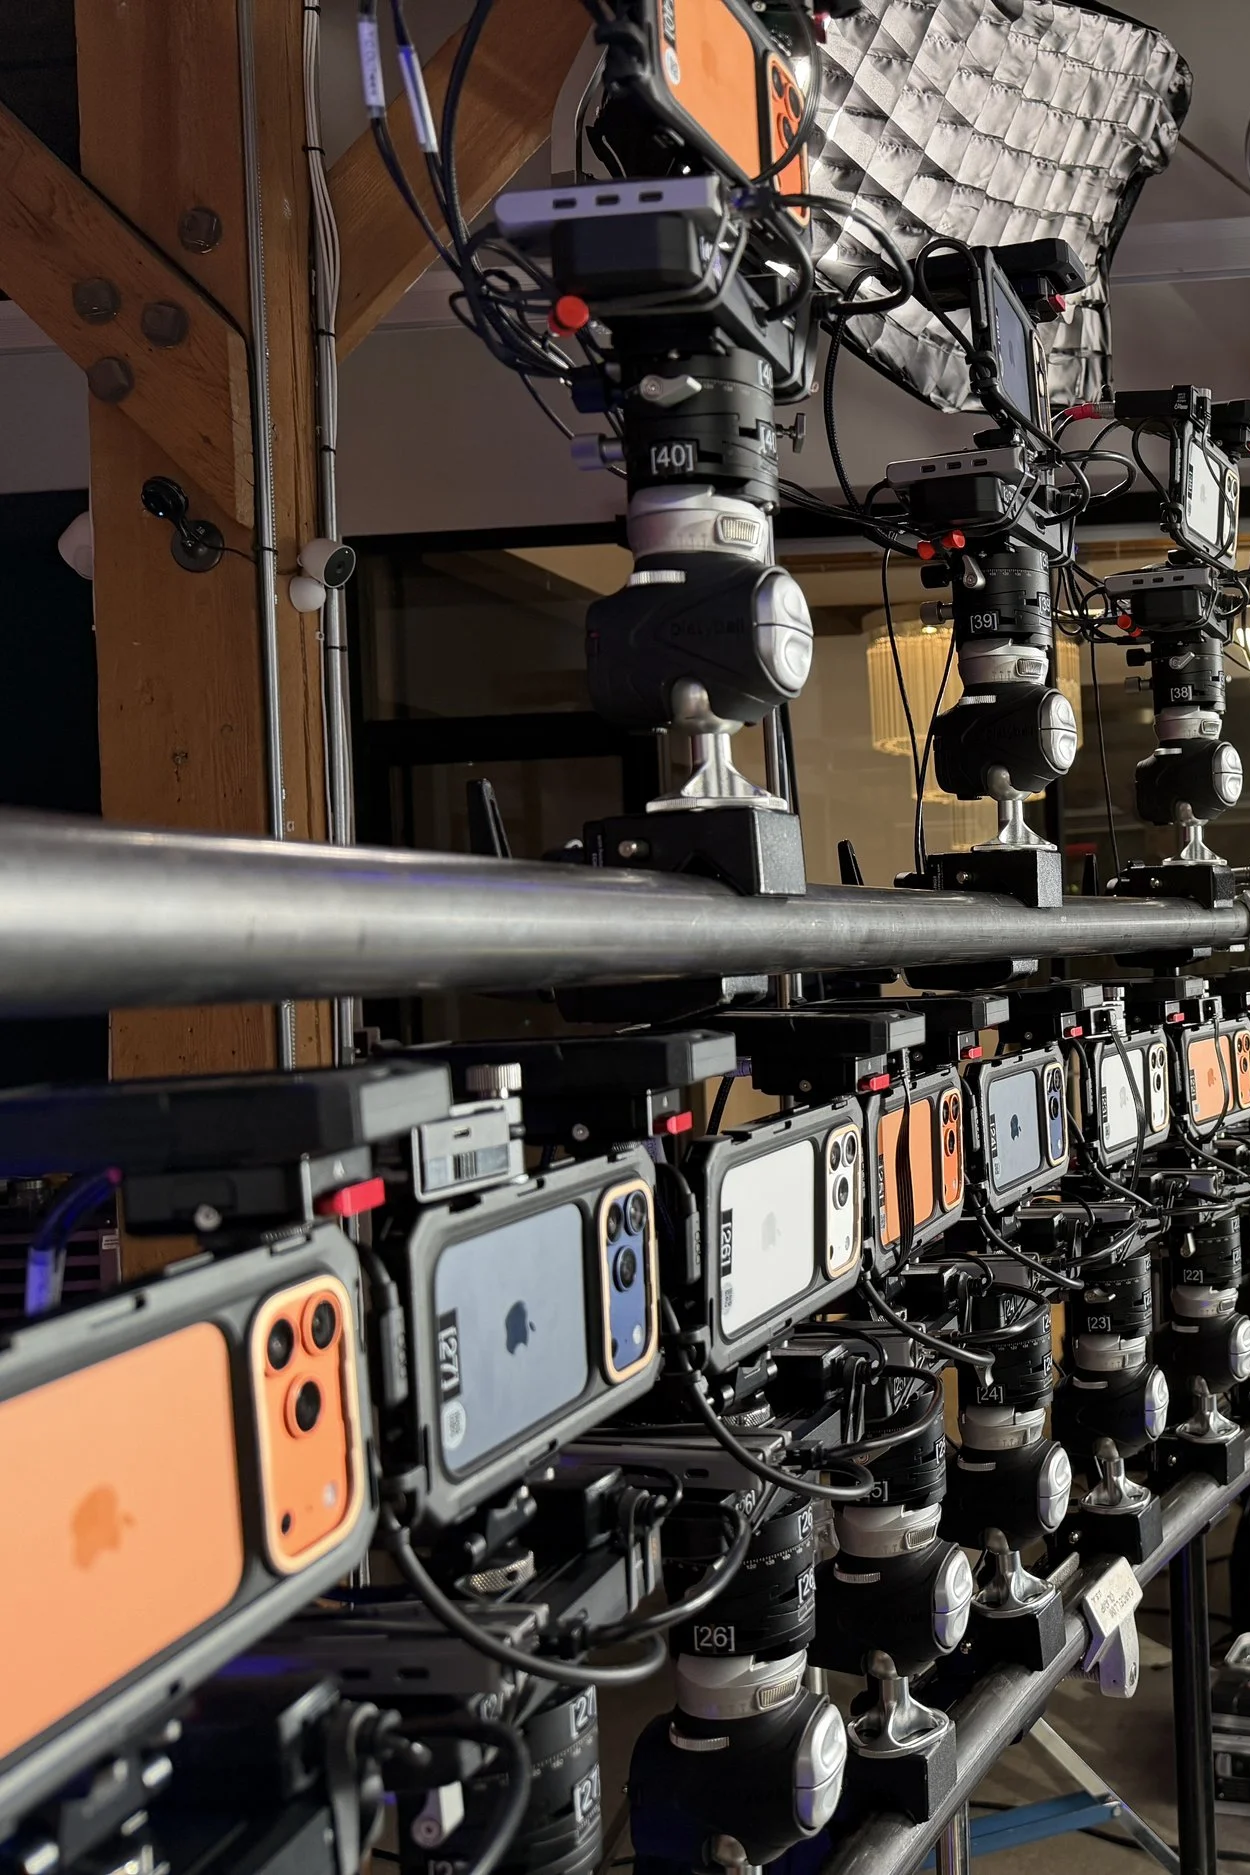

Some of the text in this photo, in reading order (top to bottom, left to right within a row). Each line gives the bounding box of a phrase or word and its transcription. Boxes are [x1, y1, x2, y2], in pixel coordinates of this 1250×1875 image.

[651, 443, 694, 475] [40]
[970, 612, 998, 633] [39]
[1170, 684, 1193, 702] [38]
[1183, 1269, 1204, 1284] [22]
[1087, 1316, 1111, 1332] [23]
[977, 1385, 1004, 1404] [24]
[694, 1625, 736, 1652] [26]
